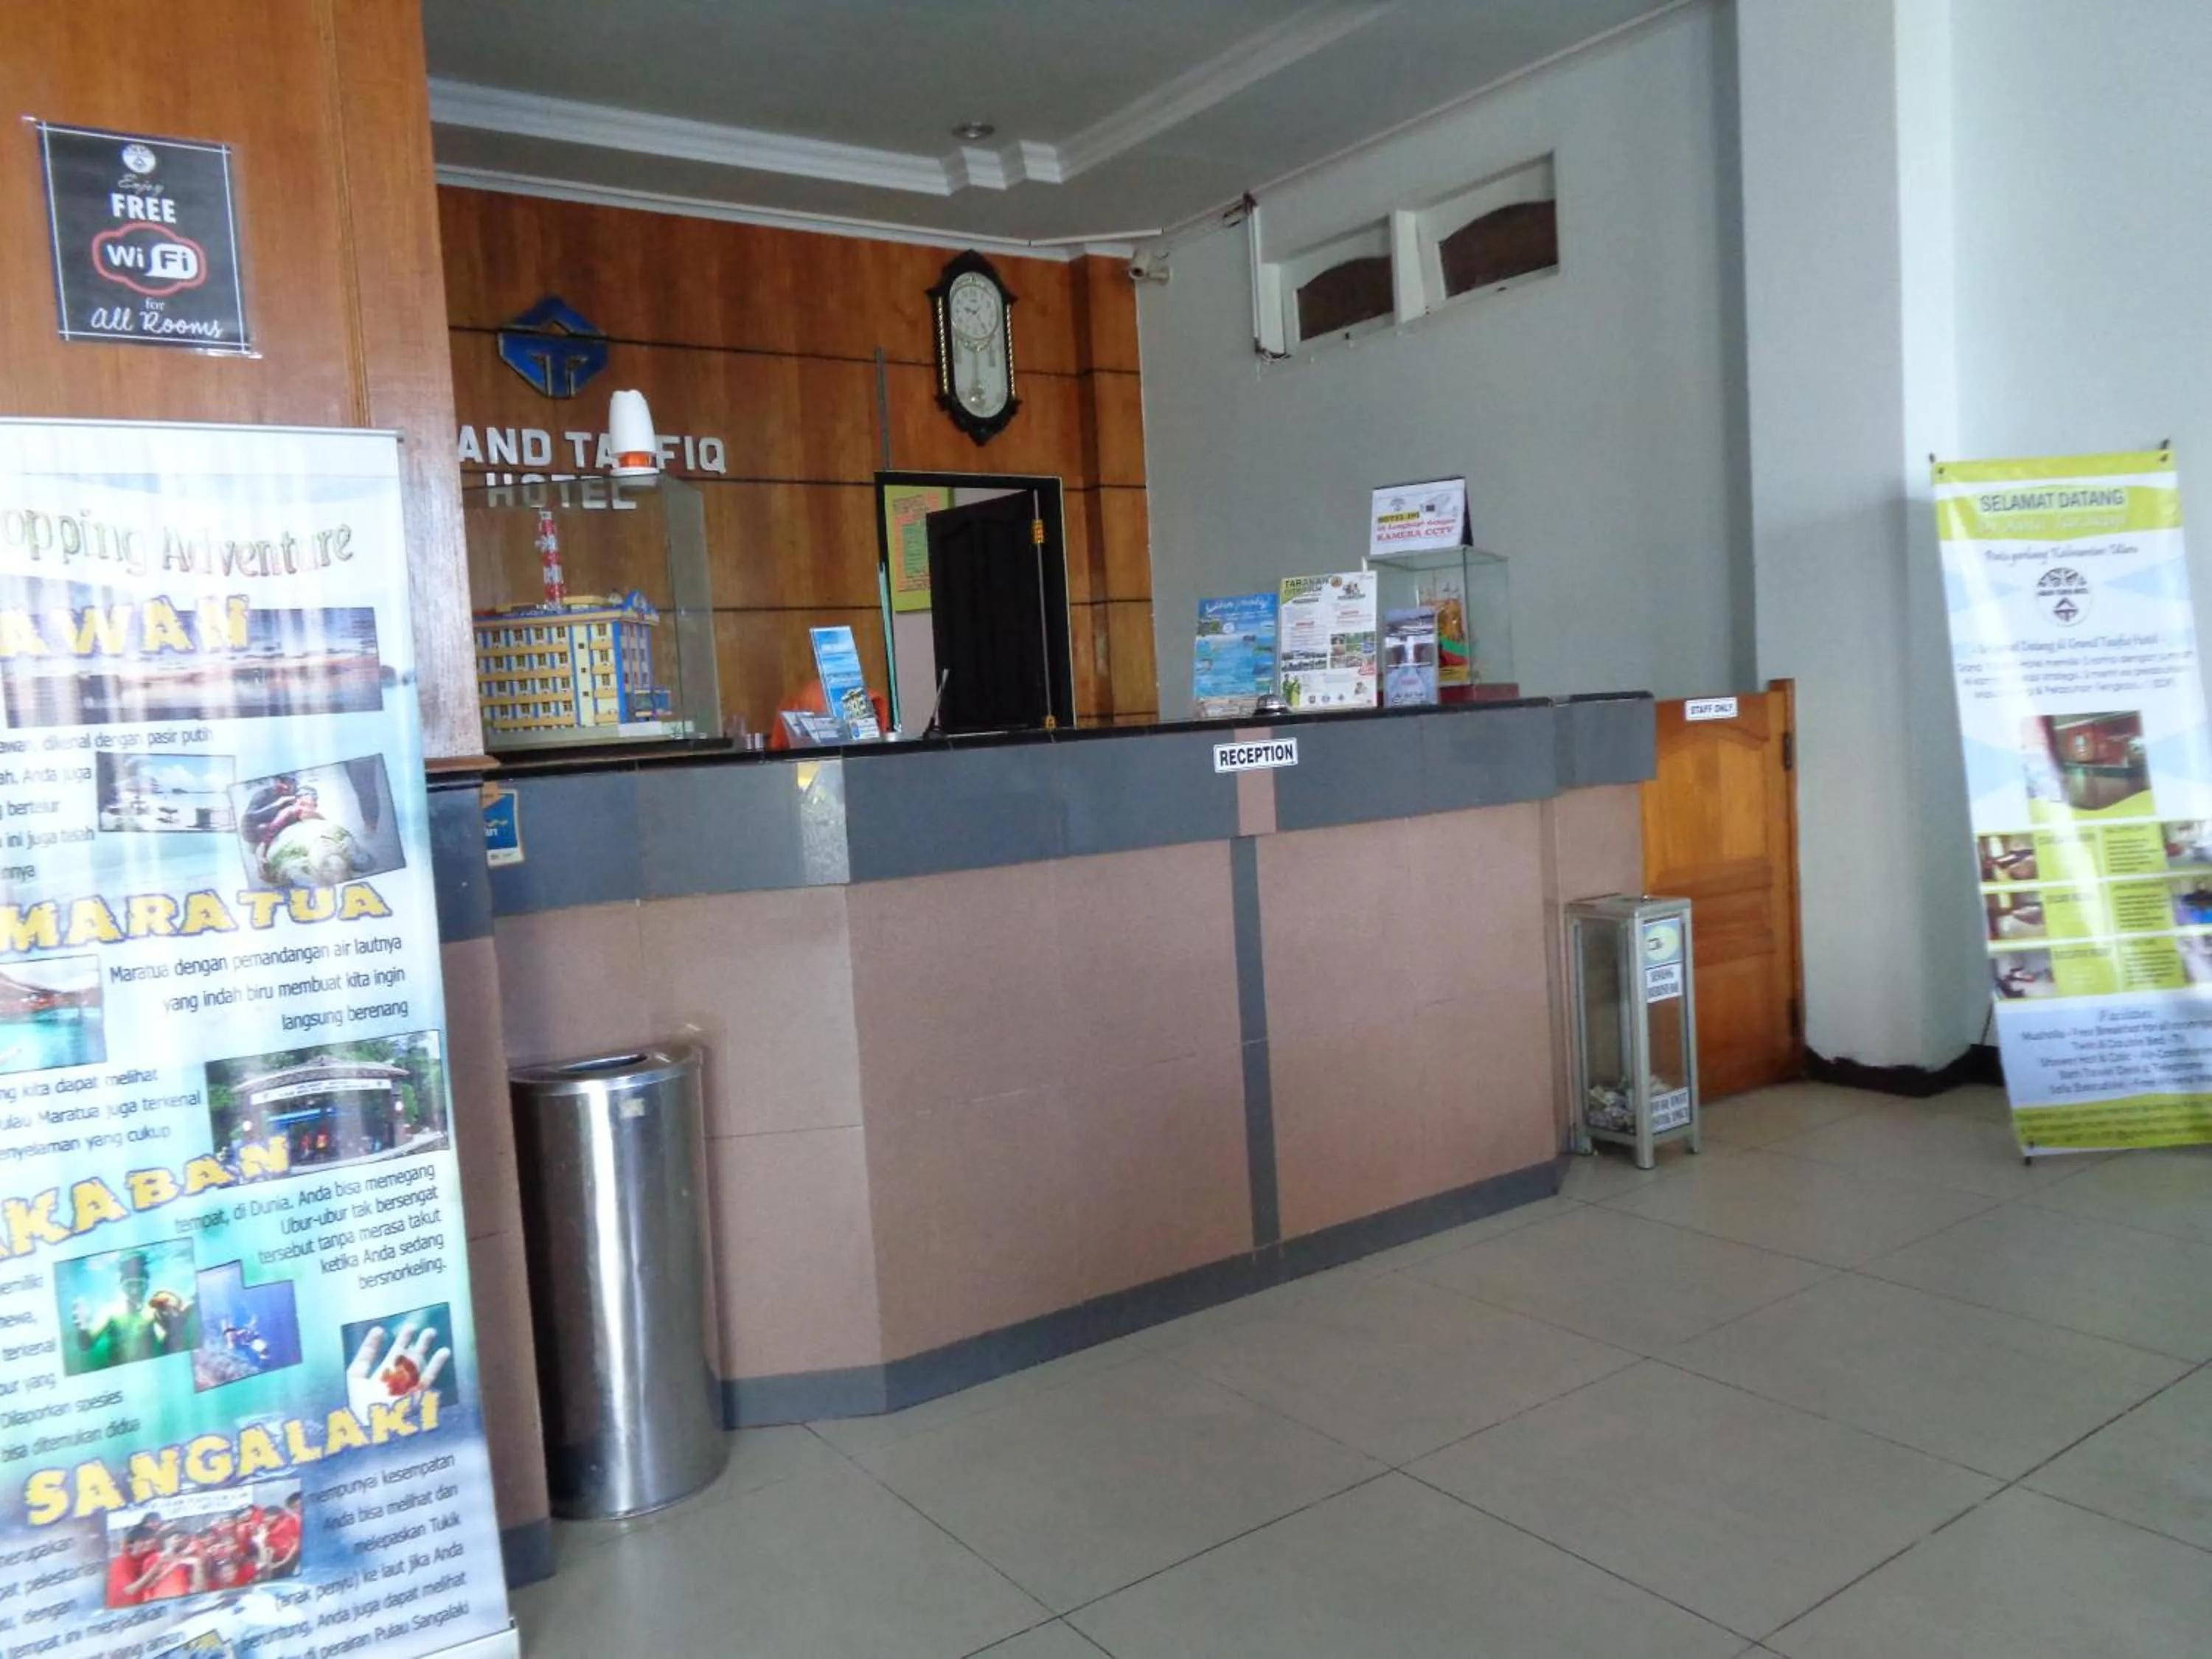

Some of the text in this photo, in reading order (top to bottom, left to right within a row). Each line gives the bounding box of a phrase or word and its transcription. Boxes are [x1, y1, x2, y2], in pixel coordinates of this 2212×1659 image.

[118, 173, 165, 195] Enjoy
[111, 192, 177, 223] FREE
[145, 296, 165, 312] for
[139, 310, 224, 338] Rooms
[565, 431, 726, 474] TAFIQ
[486, 473, 637, 509] HOTEL
[1979, 488, 2125, 512] SELAMAT DATANG
[161, 522, 355, 578] Adventure
[1376, 525, 1454, 542] KAMERA CCTV
[1690, 703, 1733, 714] STAFF ONLY
[94, 730, 143, 750] dengan
[147, 727, 178, 746] pasir
[1220, 744, 1294, 767] RECEPTION
[0, 881, 393, 953] MARATUA
[110, 934, 403, 985] Maratua dengan pemandangan air lautnya
[163, 966, 406, 1015] yang indah biru membuat kita ingin
[282, 1000, 409, 1032] langsung berenang
[55, 1076, 100, 1095] dapat
[105, 1068, 159, 1087] melihat
[38, 1105, 101, 1125] Maratua
[106, 1100, 139, 1120] juga
[142, 1090, 203, 1111] terkenal
[85, 1131, 123, 1152] yang
[128, 1124, 172, 1144] cukup
[0, 1133, 291, 1256] KABAN
[175, 1164, 437, 1234] tempat, di Dunia. Anda bisa memegang
[281, 1184, 439, 1235] Ubur-ubur tak bersengat
[258, 1207, 442, 1265] tersebut tanpa merasa takut
[320, 1232, 445, 1276] ketika Anda sedang
[358, 1256, 448, 1290] bersnorkeling.
[22, 1391, 442, 1529] SANGALAKI
[381, 1454, 456, 1485] kesempatan
[323, 1483, 459, 1533] Anda bisa melihat dan
[354, 1511, 462, 1555] melepaskan Tukik
[363, 1568, 379, 1584] ke
[381, 1559, 406, 1579] laut
[408, 1551, 431, 1576] jika
[434, 1541, 465, 1562] Anda
[317, 1608, 351, 1630] Anda
[353, 1598, 381, 1618] juga
[383, 1585, 419, 1609] dapat
[422, 1571, 468, 1596] melihat
[412, 1601, 470, 1632] Sangalaki
